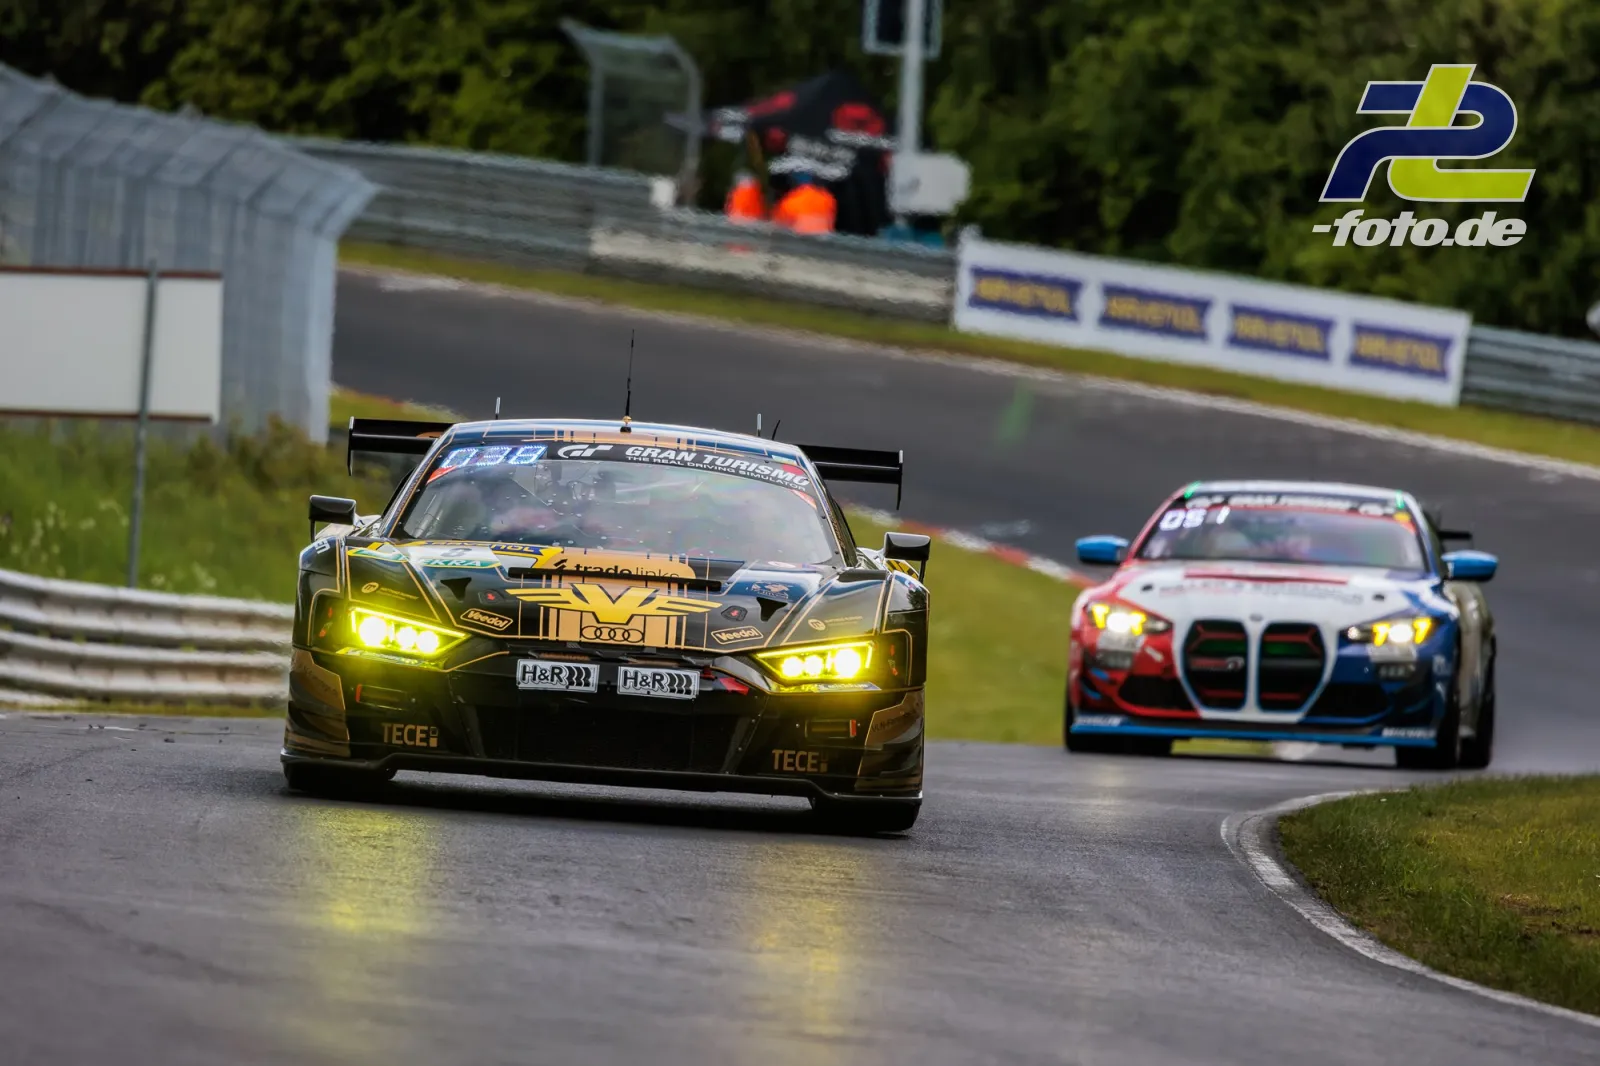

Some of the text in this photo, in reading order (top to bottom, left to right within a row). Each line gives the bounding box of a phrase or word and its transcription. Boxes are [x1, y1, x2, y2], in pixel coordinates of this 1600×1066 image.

[625, 446, 697, 463] GRAN
[653, 457, 685, 466] REAL
[687, 461, 736, 474] DRIVING
[738, 470, 807, 491] SIMULATOR
[466, 610, 507, 628] Veedol
[716, 626, 759, 641] Veedol
[521, 663, 564, 684] H&R
[622, 670, 666, 690] H&R
[382, 722, 429, 746] TECE
[772, 749, 819, 772] TECE
